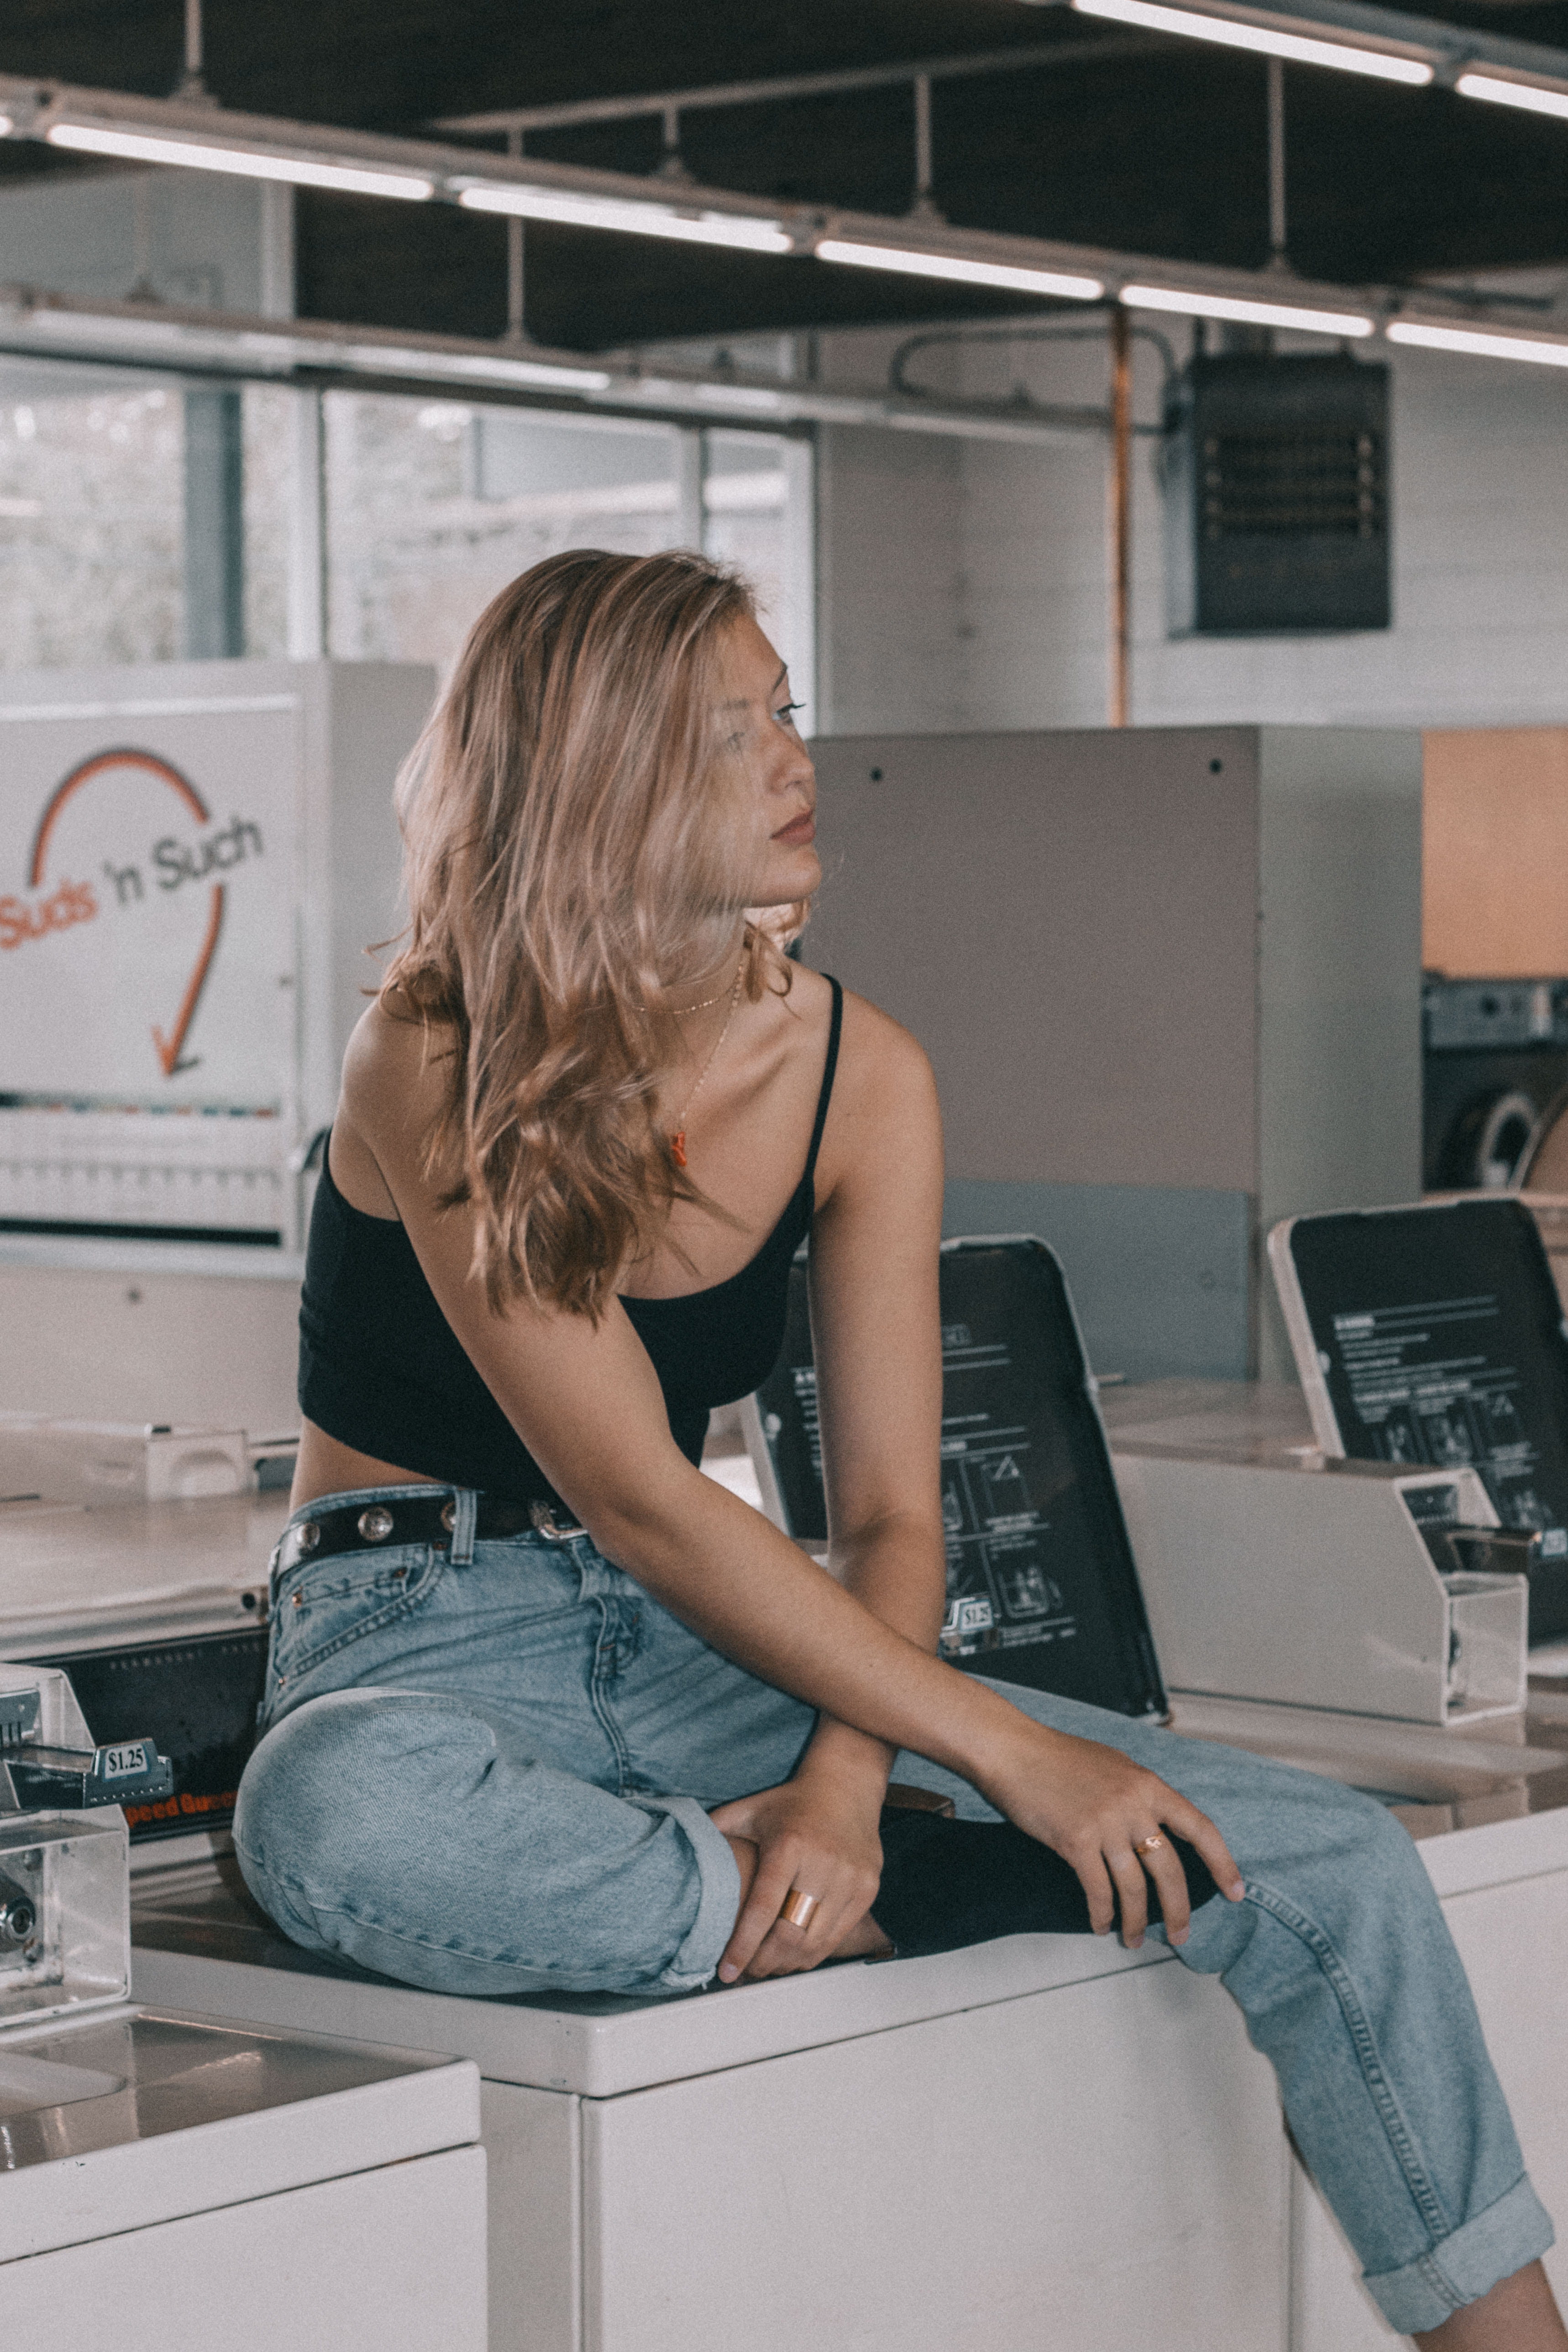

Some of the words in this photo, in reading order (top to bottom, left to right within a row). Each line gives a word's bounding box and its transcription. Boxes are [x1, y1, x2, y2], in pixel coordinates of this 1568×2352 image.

[0, 877, 97, 950] Suds
[151, 816, 265, 891] Such
[109, 1748, 143, 1772] $1.25
[123, 1796, 179, 1828] peed
[181, 1791, 237, 1814] Quee
